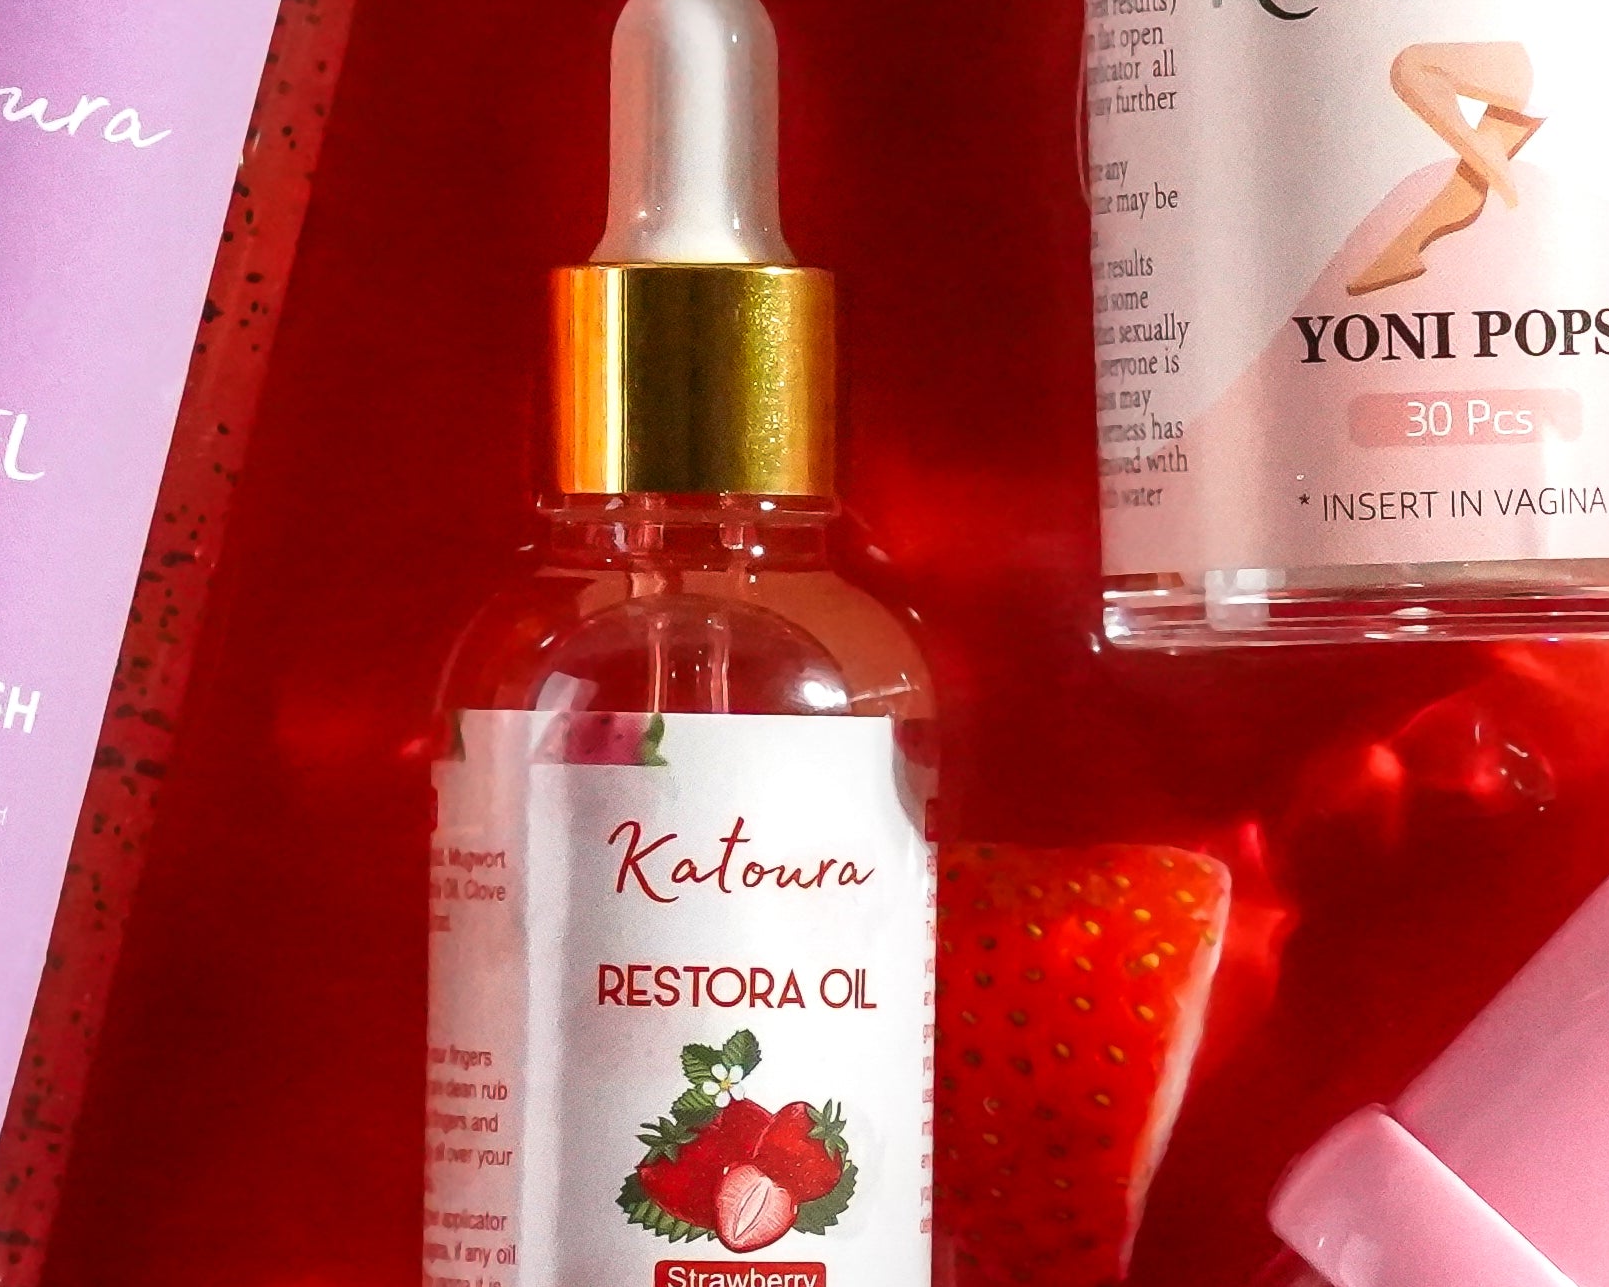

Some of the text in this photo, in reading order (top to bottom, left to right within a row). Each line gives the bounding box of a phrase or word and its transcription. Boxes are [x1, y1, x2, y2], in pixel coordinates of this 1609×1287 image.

[1119, 25, 1164, 57] open
[1152, 48, 1176, 78] all
[1115, 83, 1177, 115] further
[1116, 191, 1150, 220] may
[1154, 181, 1179, 209] be
[1106, 247, 1154, 280] results
[1111, 288, 1149, 311] some
[1119, 312, 1190, 349] sexually
[1292, 310, 1456, 364] YONI
[1164, 348, 1180, 374] is
[1151, 411, 1184, 440] has
[1405, 398, 1534, 438] 30 Pcs
[1146, 444, 1189, 473] with
[1322, 486, 1608, 522] INSERT IN VAGINA
[607, 815, 876, 904] Katoura
[597, 962, 807, 1010] RESTORA
[818, 967, 878, 1010] OIL
[481, 1079, 508, 1101] rub
[471, 1112, 499, 1133] and
[477, 1148, 513, 1169] your
[496, 1243, 516, 1265] oil
